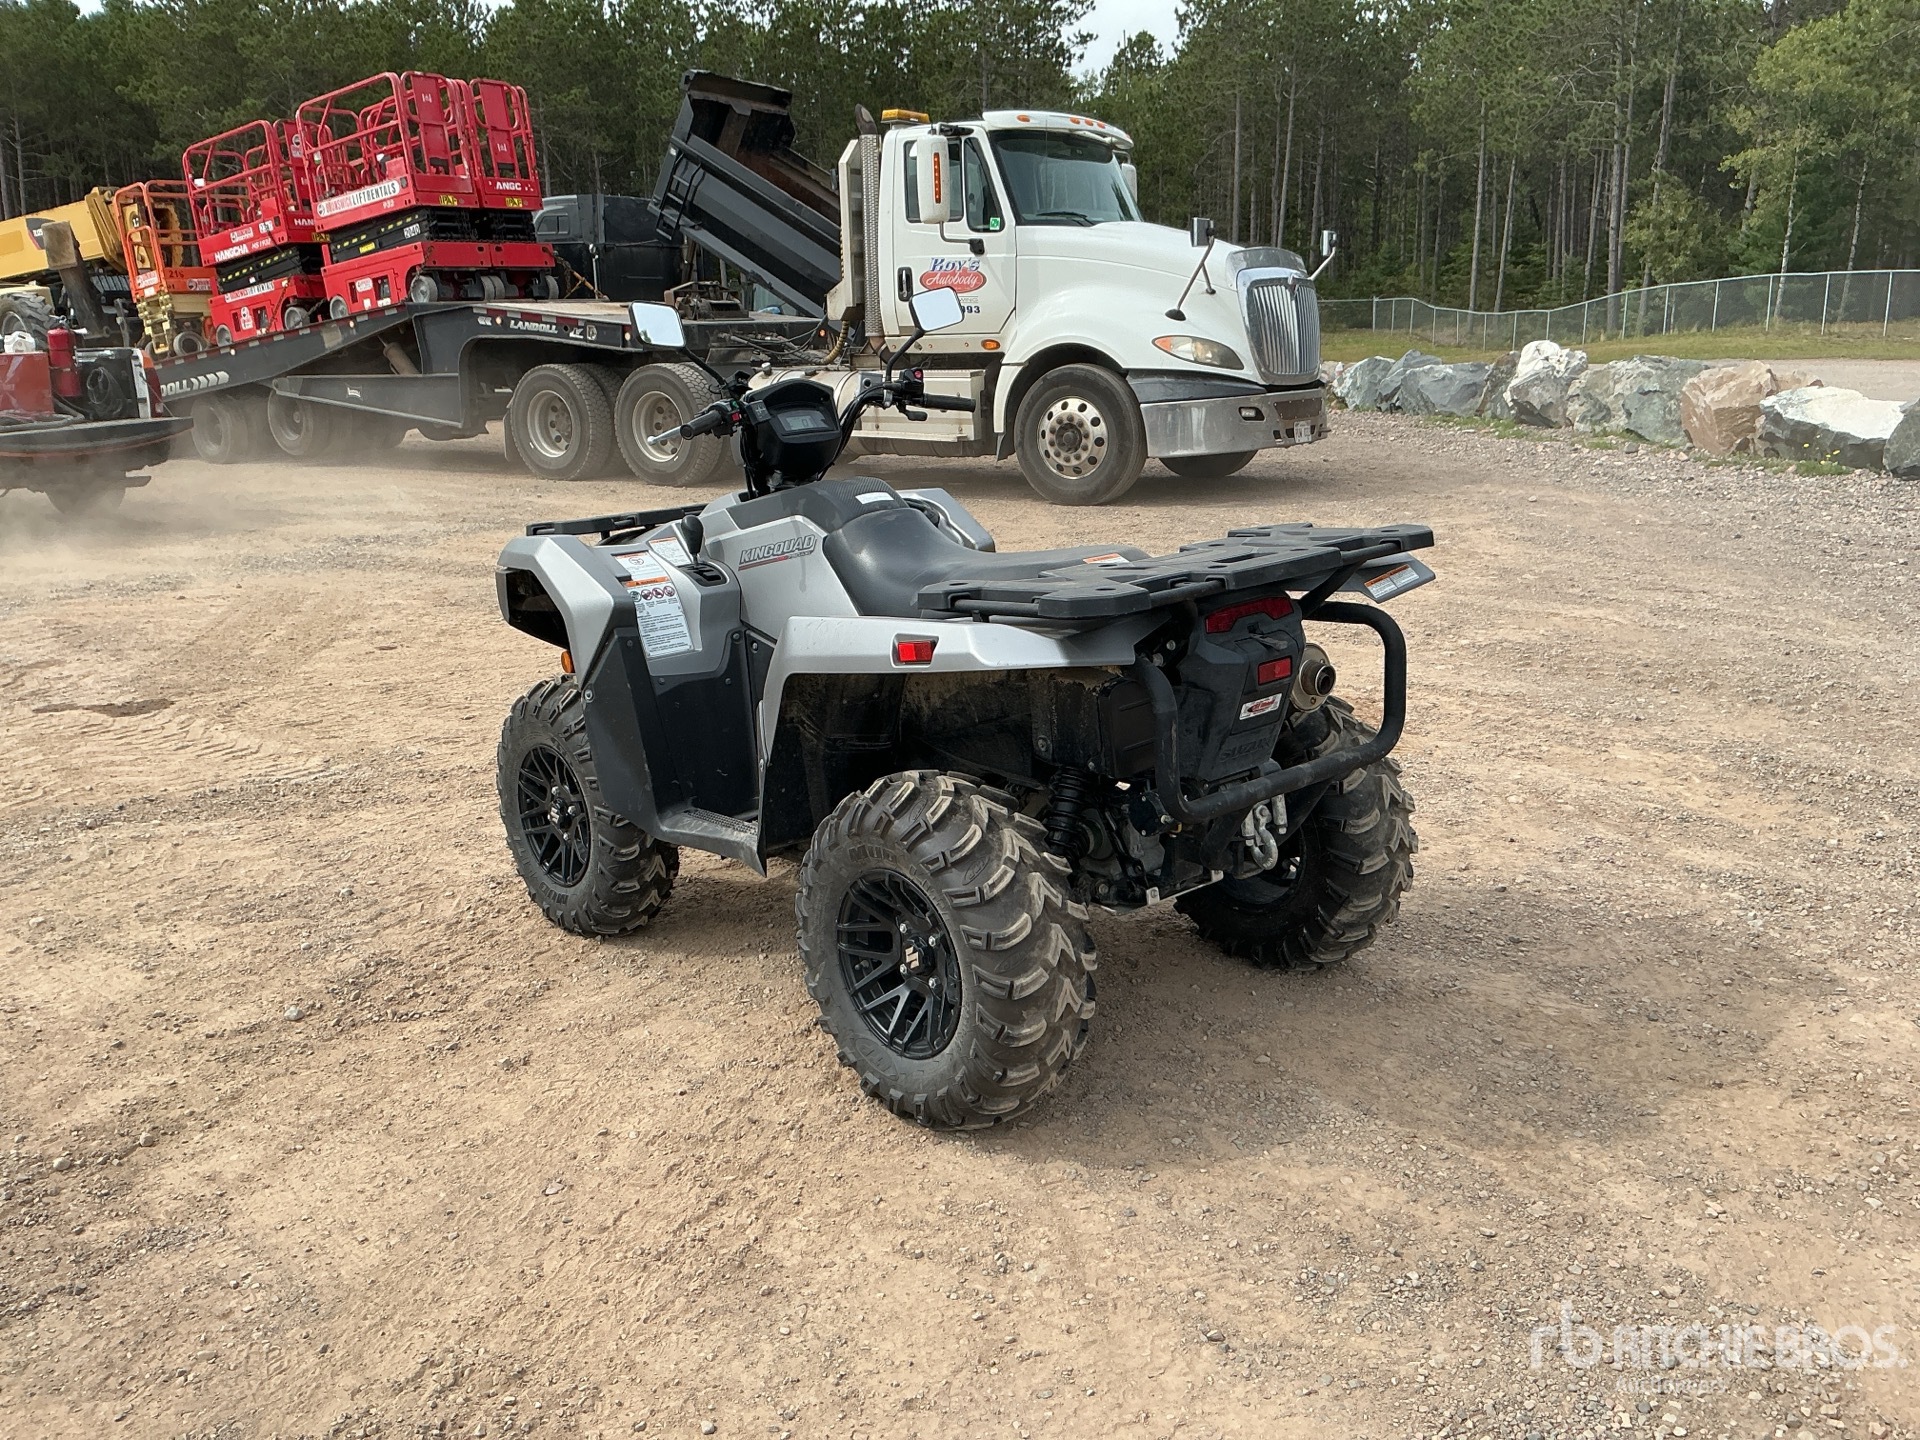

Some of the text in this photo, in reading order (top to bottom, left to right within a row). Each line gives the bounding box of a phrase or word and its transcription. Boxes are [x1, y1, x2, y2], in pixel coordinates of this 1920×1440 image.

[214, 244, 249, 262] HANGCHA
[926, 273, 978, 288] Autobody
[510, 319, 558, 334] LANDOLL
[739, 534, 816, 565] KINGQUAD
